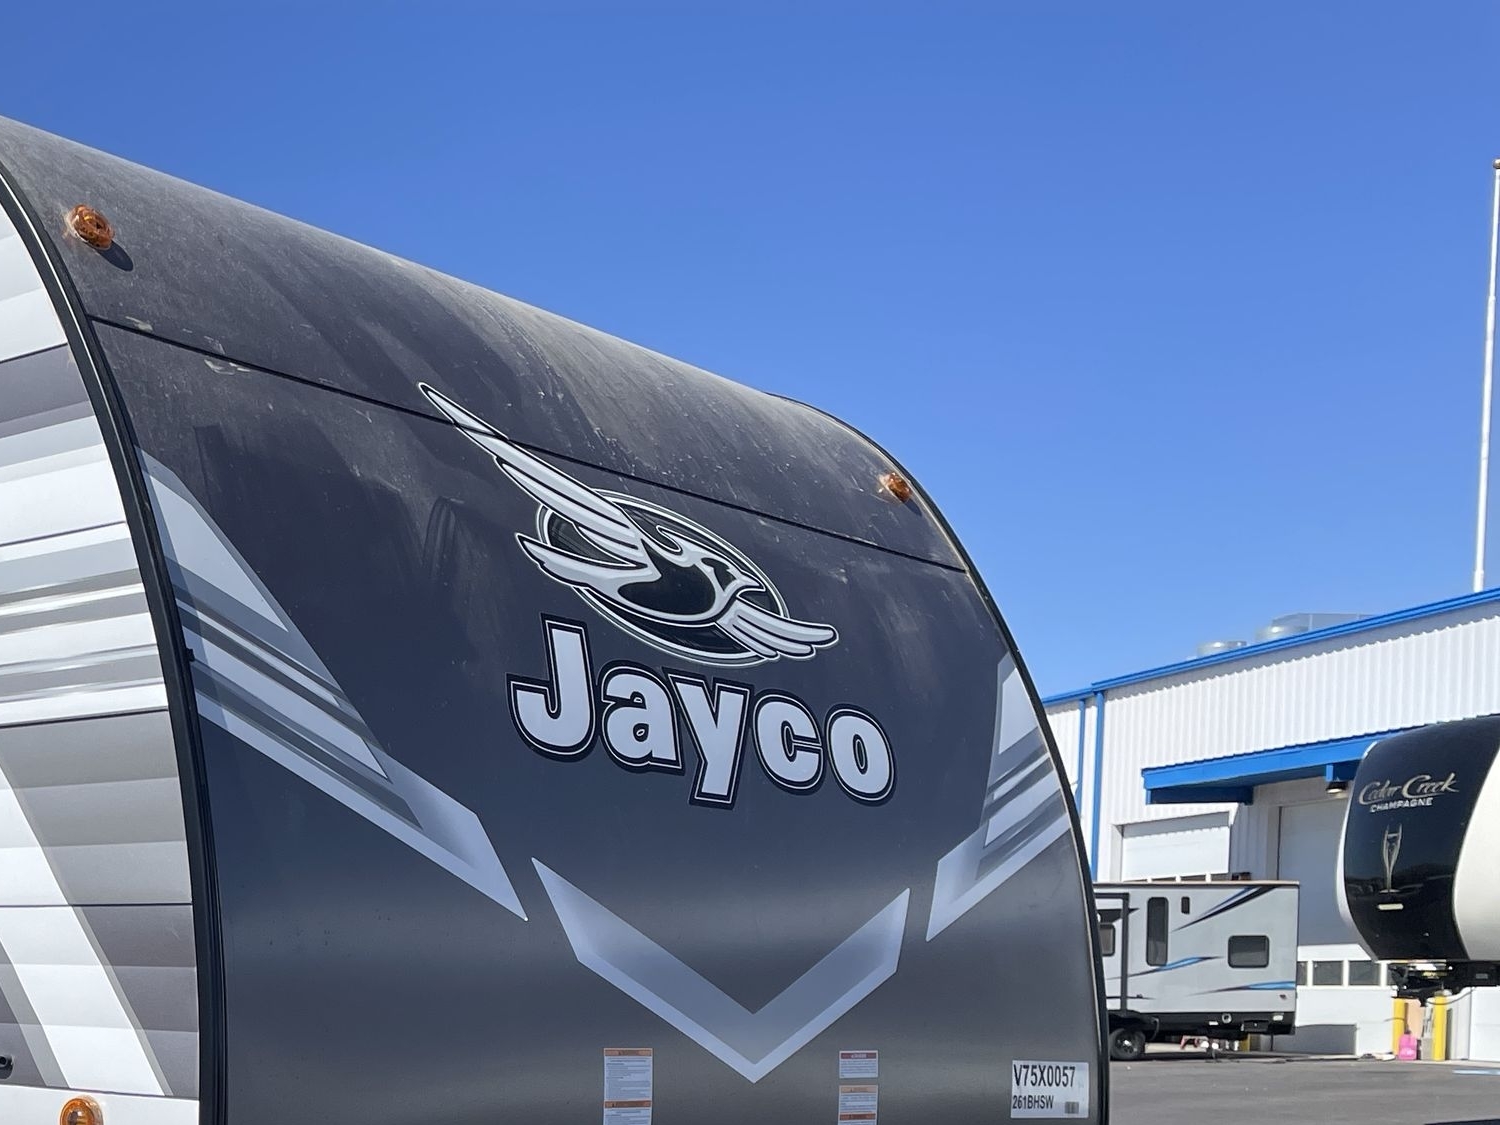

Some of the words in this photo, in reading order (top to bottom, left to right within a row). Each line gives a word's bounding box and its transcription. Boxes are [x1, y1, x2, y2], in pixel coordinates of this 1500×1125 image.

[508, 617, 896, 805] Jayco
[1402, 773, 1460, 799] Creek
[1370, 797, 1433, 813] CHAMPAGNE
[1013, 1064, 1076, 1087] V75X0057
[1012, 1095, 1054, 1109] 261BHSW
